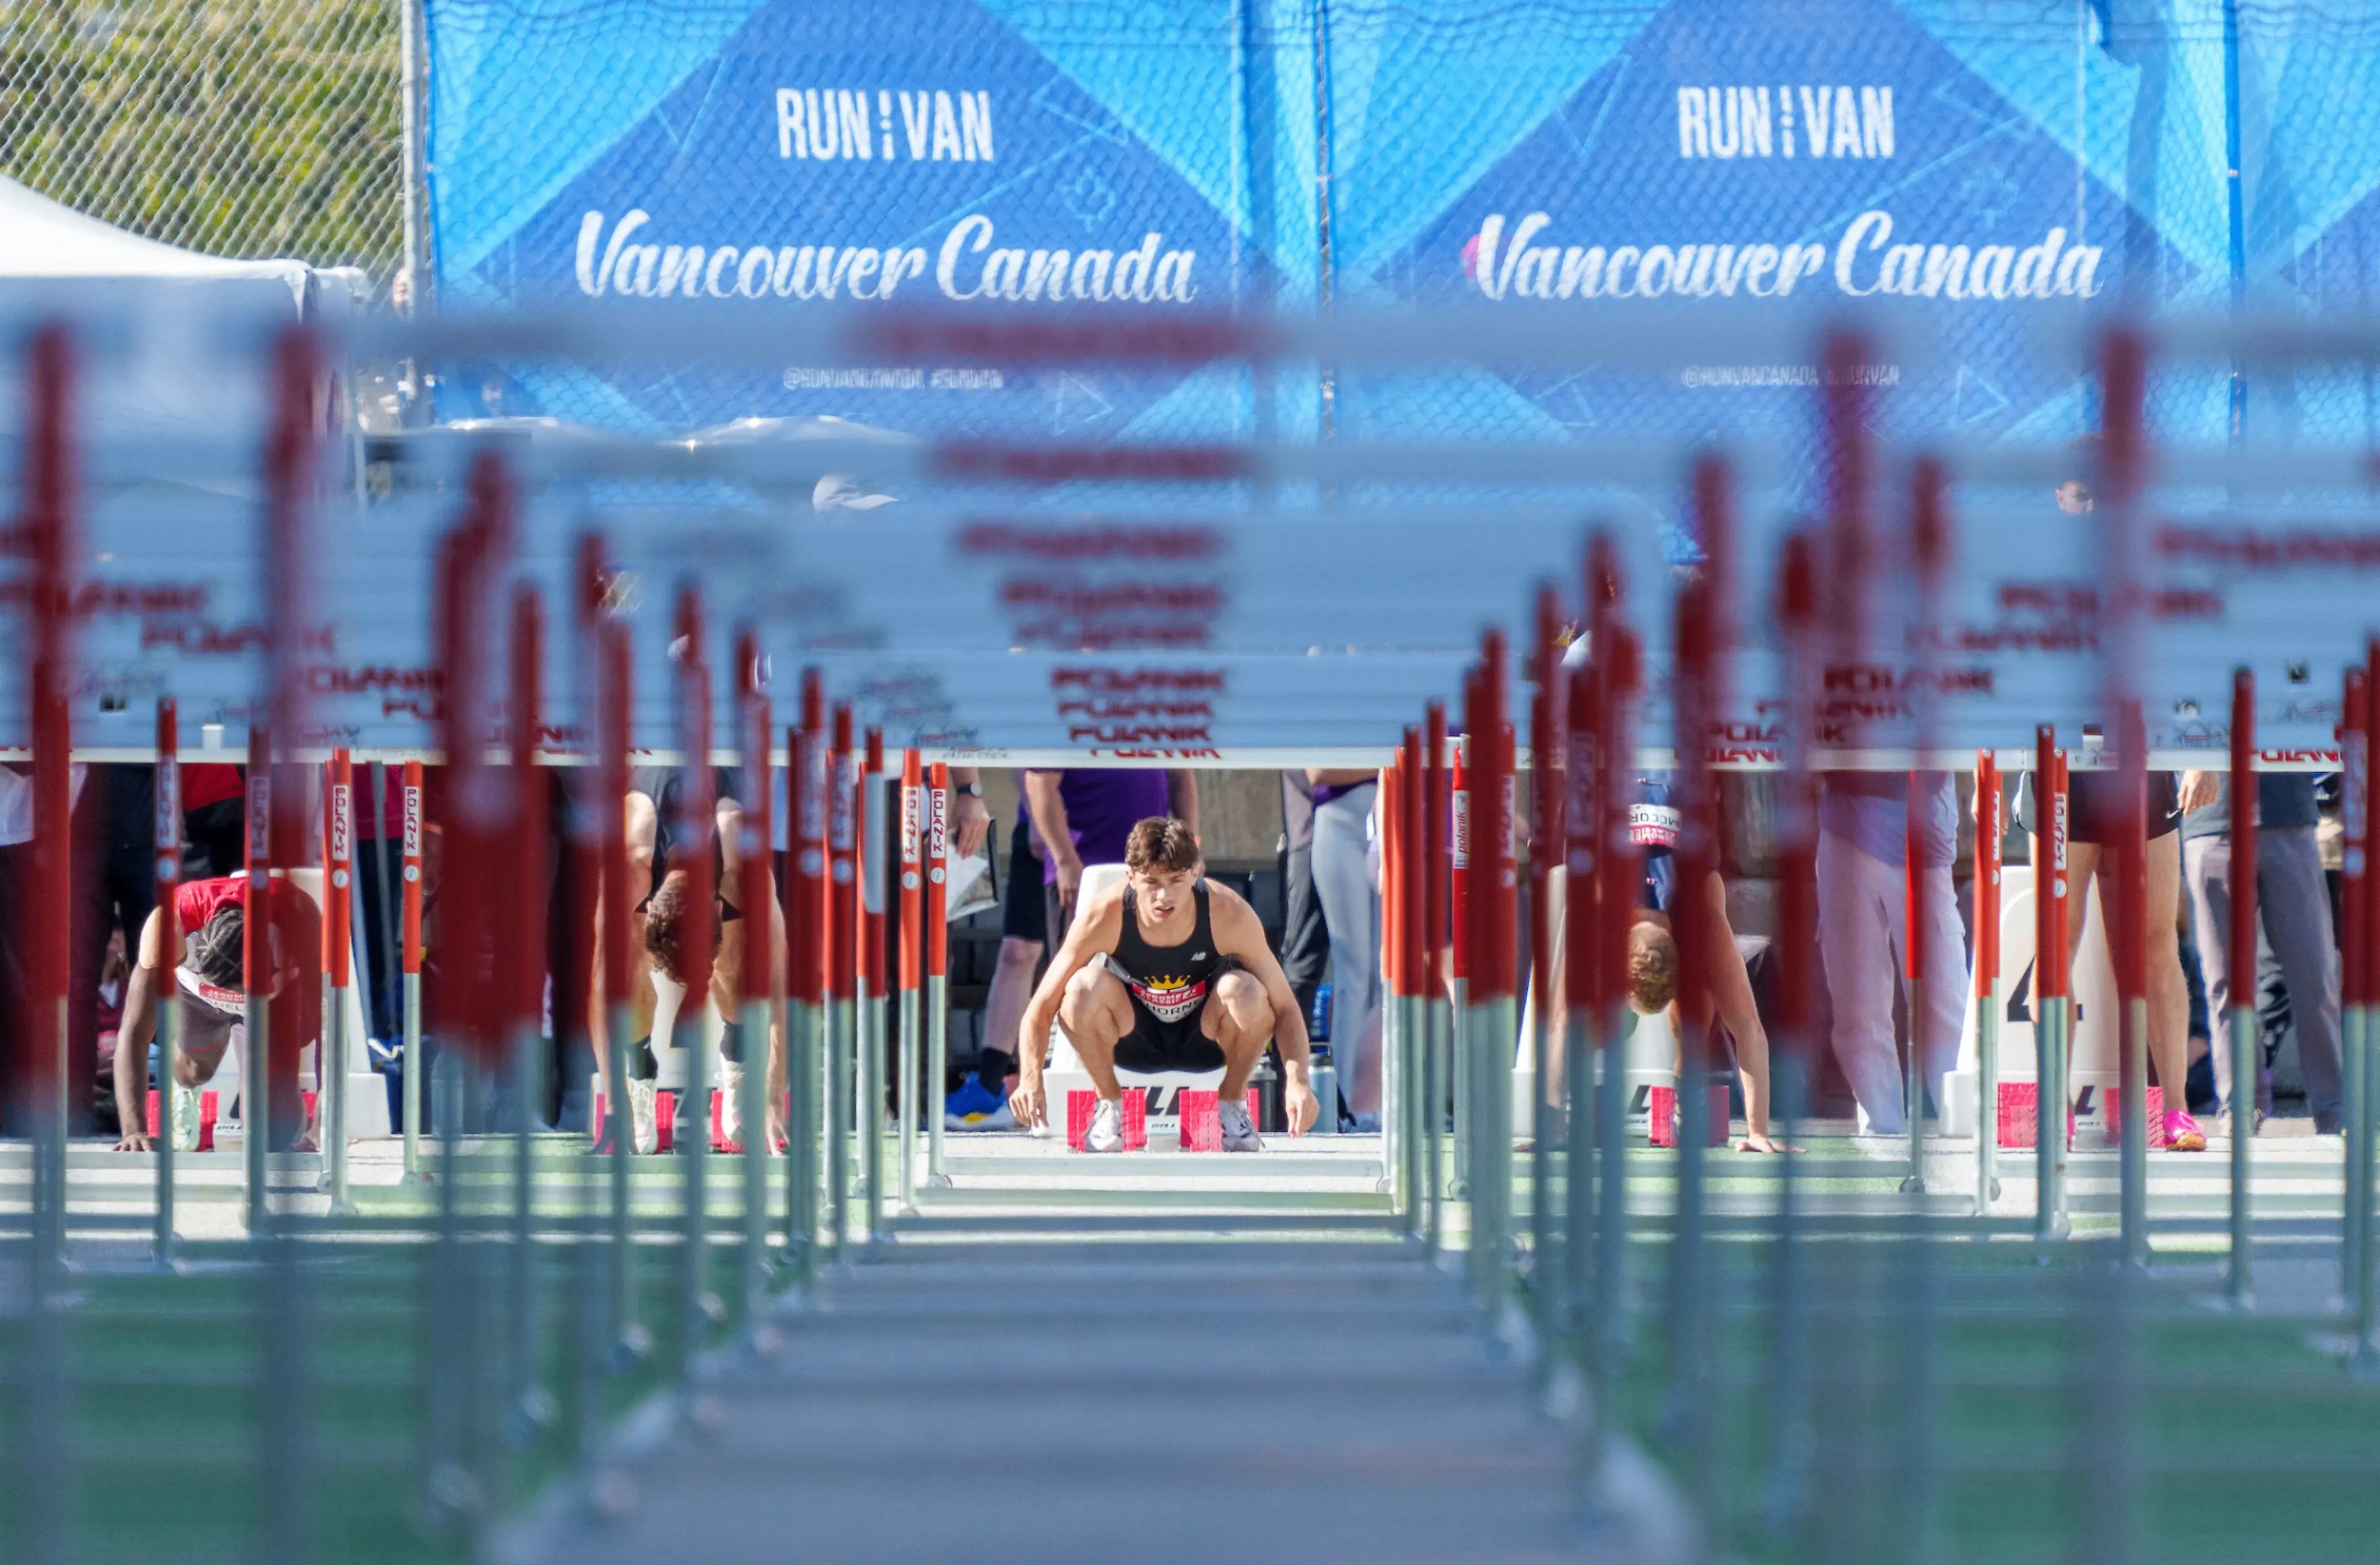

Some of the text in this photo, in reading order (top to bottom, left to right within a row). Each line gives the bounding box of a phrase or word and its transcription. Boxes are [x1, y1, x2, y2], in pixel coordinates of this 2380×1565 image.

[776, 88, 994, 162] RUN VAN
[1677, 85, 1894, 159] RUN VAN
[574, 208, 1199, 302] Vancouver Canada
[1476, 209, 2104, 300] Vancouver Canada
[335, 787, 346, 853] POLANIK
[407, 788, 417, 850] POLANIK
[932, 791, 945, 852] POLANIK
